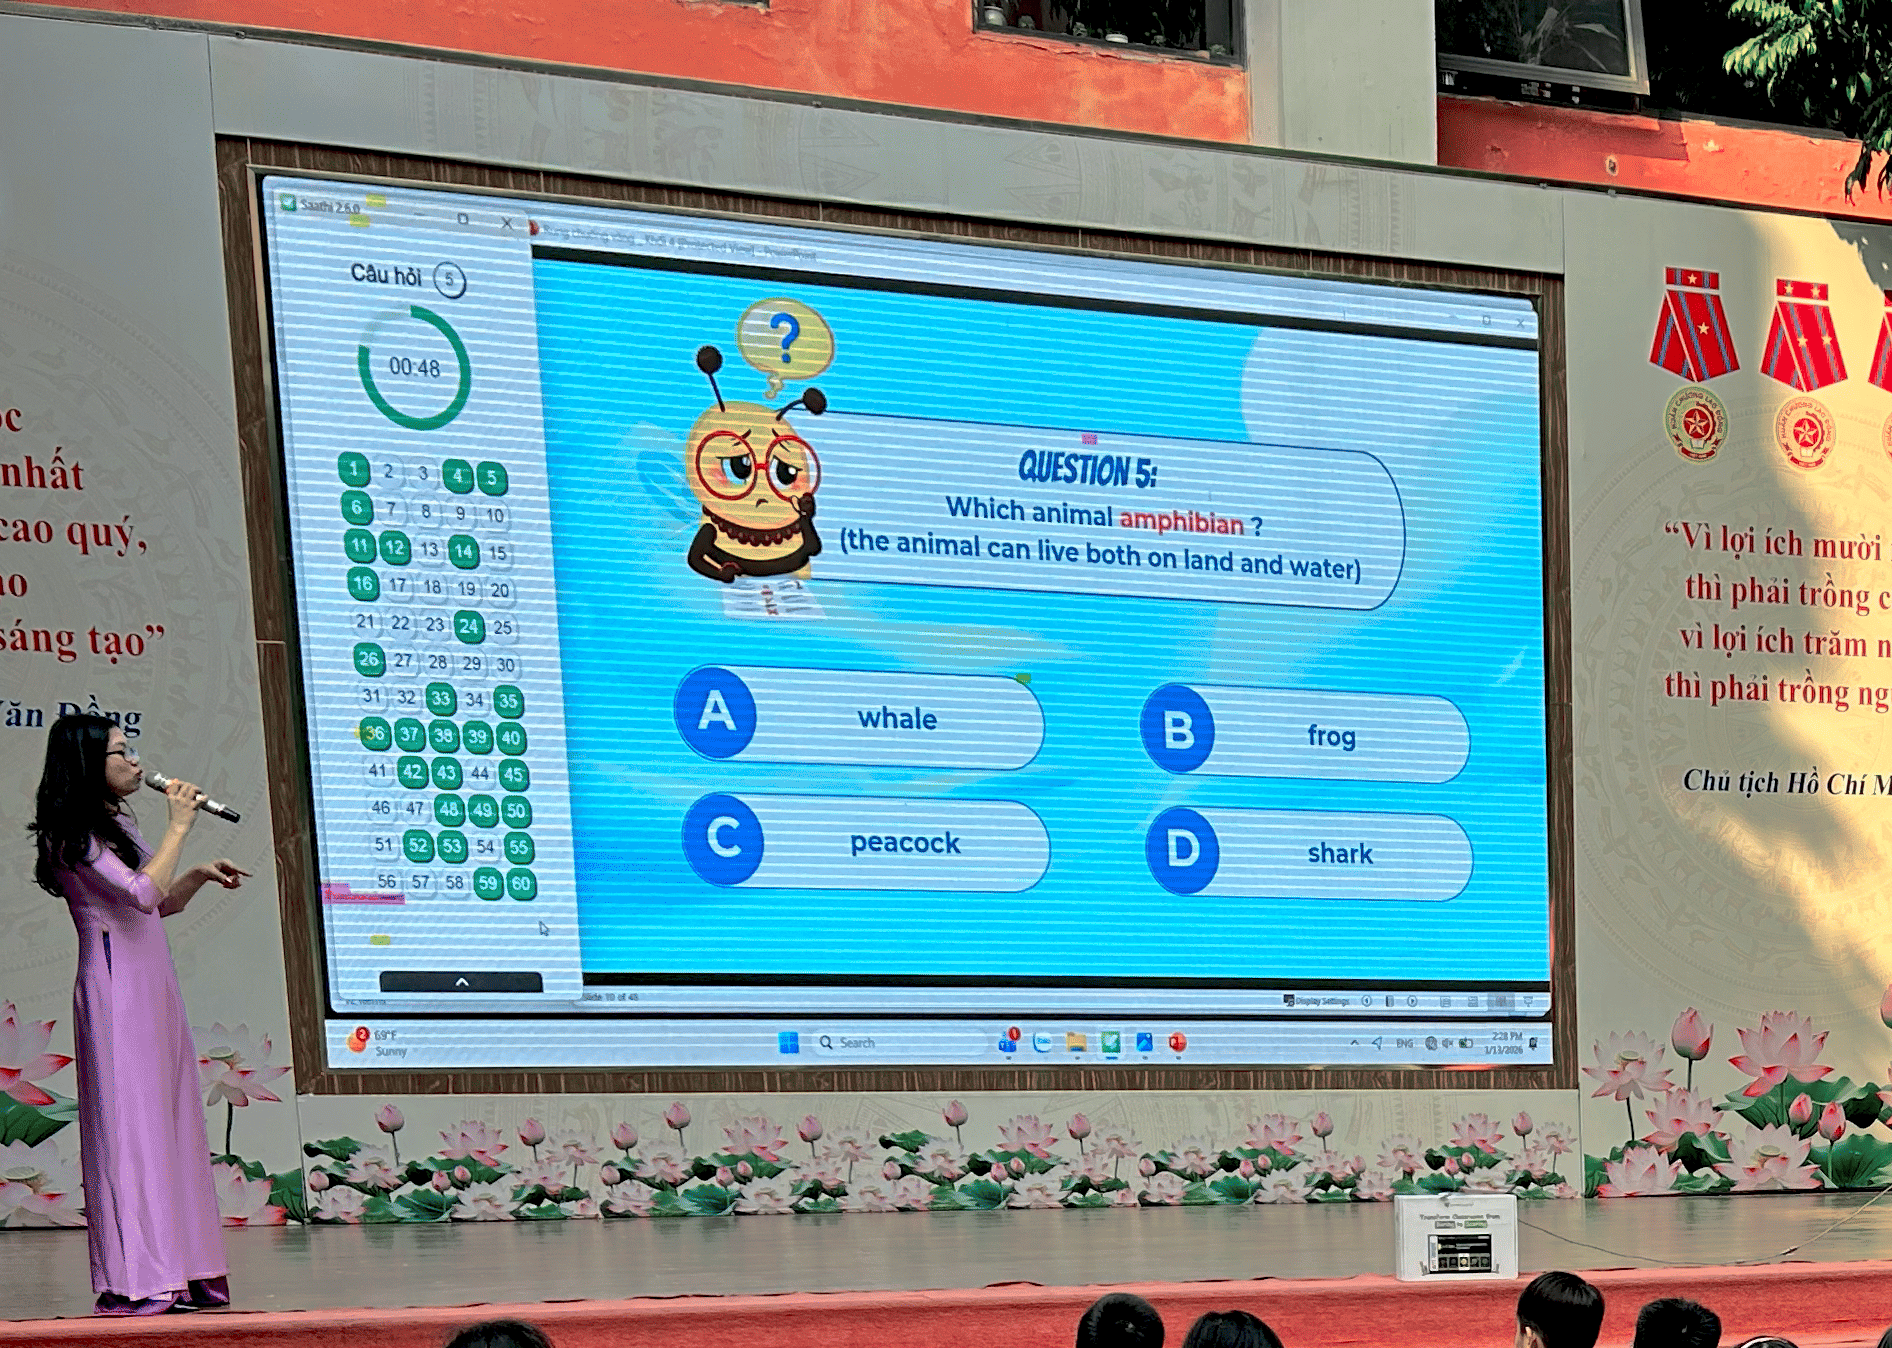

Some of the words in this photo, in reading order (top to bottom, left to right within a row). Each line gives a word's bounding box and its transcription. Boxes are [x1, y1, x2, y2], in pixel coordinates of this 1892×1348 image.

[351, 263, 389, 284] Câu
[394, 266, 422, 287] hỏi
[445, 272, 454, 287] 5
[390, 356, 441, 379] 00:48
[0, 446, 84, 491] nhất
[350, 461, 358, 476] 1
[384, 464, 394, 478] 2
[418, 466, 428, 480] 3
[453, 468, 464, 483] 4
[487, 470, 497, 486] 5
[1018, 449, 1130, 486] QUESTION
[1135, 458, 1158, 488] 5:
[946, 495, 1025, 521] Which
[1032, 503, 1112, 527] animal
[1120, 510, 1244, 536] amphibian
[1251, 516, 1263, 537] ?
[67, 515, 147, 557] quý,
[352, 538, 368, 552] 11
[386, 540, 405, 556] 12
[421, 542, 439, 557] 13
[455, 544, 473, 559] 14
[490, 546, 507, 560] 15
[1722, 525, 1755, 560] lợi
[1765, 527, 1803, 557] ích
[1813, 534, 1881, 561] mười
[840, 527, 889, 554] (the
[897, 531, 980, 557] animal
[987, 540, 1030, 560] can
[1038, 538, 1079, 562] live
[1086, 542, 1140, 567] both
[1148, 549, 1177, 569] on
[1184, 548, 1233, 572] land
[1241, 554, 1283, 575] and
[1290, 559, 1361, 584] water)
[1686, 572, 1722, 600] thì
[1731, 576, 1790, 610] phải
[1799, 572, 1870, 617] trồng
[356, 614, 374, 628] 21
[392, 615, 410, 630] 22
[426, 617, 444, 632] 23
[460, 618, 479, 634] 24
[494, 620, 512, 635] 25
[1680, 622, 1703, 649] vì
[1713, 624, 1747, 659] lợi
[1756, 625, 1794, 654] ích
[1804, 629, 1867, 657] trăm
[363, 688, 380, 702] 31
[398, 690, 416, 704] 32
[432, 691, 451, 706] 33
[466, 693, 484, 707] 34
[500, 694, 518, 708] 35
[1665, 671, 1702, 698] thì
[1710, 673, 1769, 707] phải
[1778, 668, 1849, 712] trồng
[698, 689, 737, 732] A
[857, 705, 938, 730] whale
[400, 727, 418, 742] 37
[434, 728, 453, 743] 38
[468, 730, 487, 744] 39
[502, 730, 520, 745] 40
[1164, 710, 1195, 749] B
[1308, 724, 1356, 752] frog
[1684, 768, 1730, 792] Chủ
[1739, 770, 1779, 798] tịch
[1787, 766, 1819, 795] Hồ
[1827, 773, 1869, 796] Chí
[372, 800, 390, 814] 46
[406, 802, 424, 816] 47
[440, 802, 458, 816] 48
[474, 803, 492, 818] 49
[506, 804, 526, 818] 50
[706, 815, 742, 858] C
[850, 831, 961, 856] peacock
[1167, 828, 1200, 867] D
[1308, 841, 1374, 865] shark
[378, 874, 396, 888] 56
[412, 875, 430, 889] 57
[446, 876, 464, 890] 58
[479, 876, 498, 890] 59
[512, 876, 530, 891] 60
[376, 1046, 408, 1059] Sunny
[840, 1036, 876, 1049] Search
